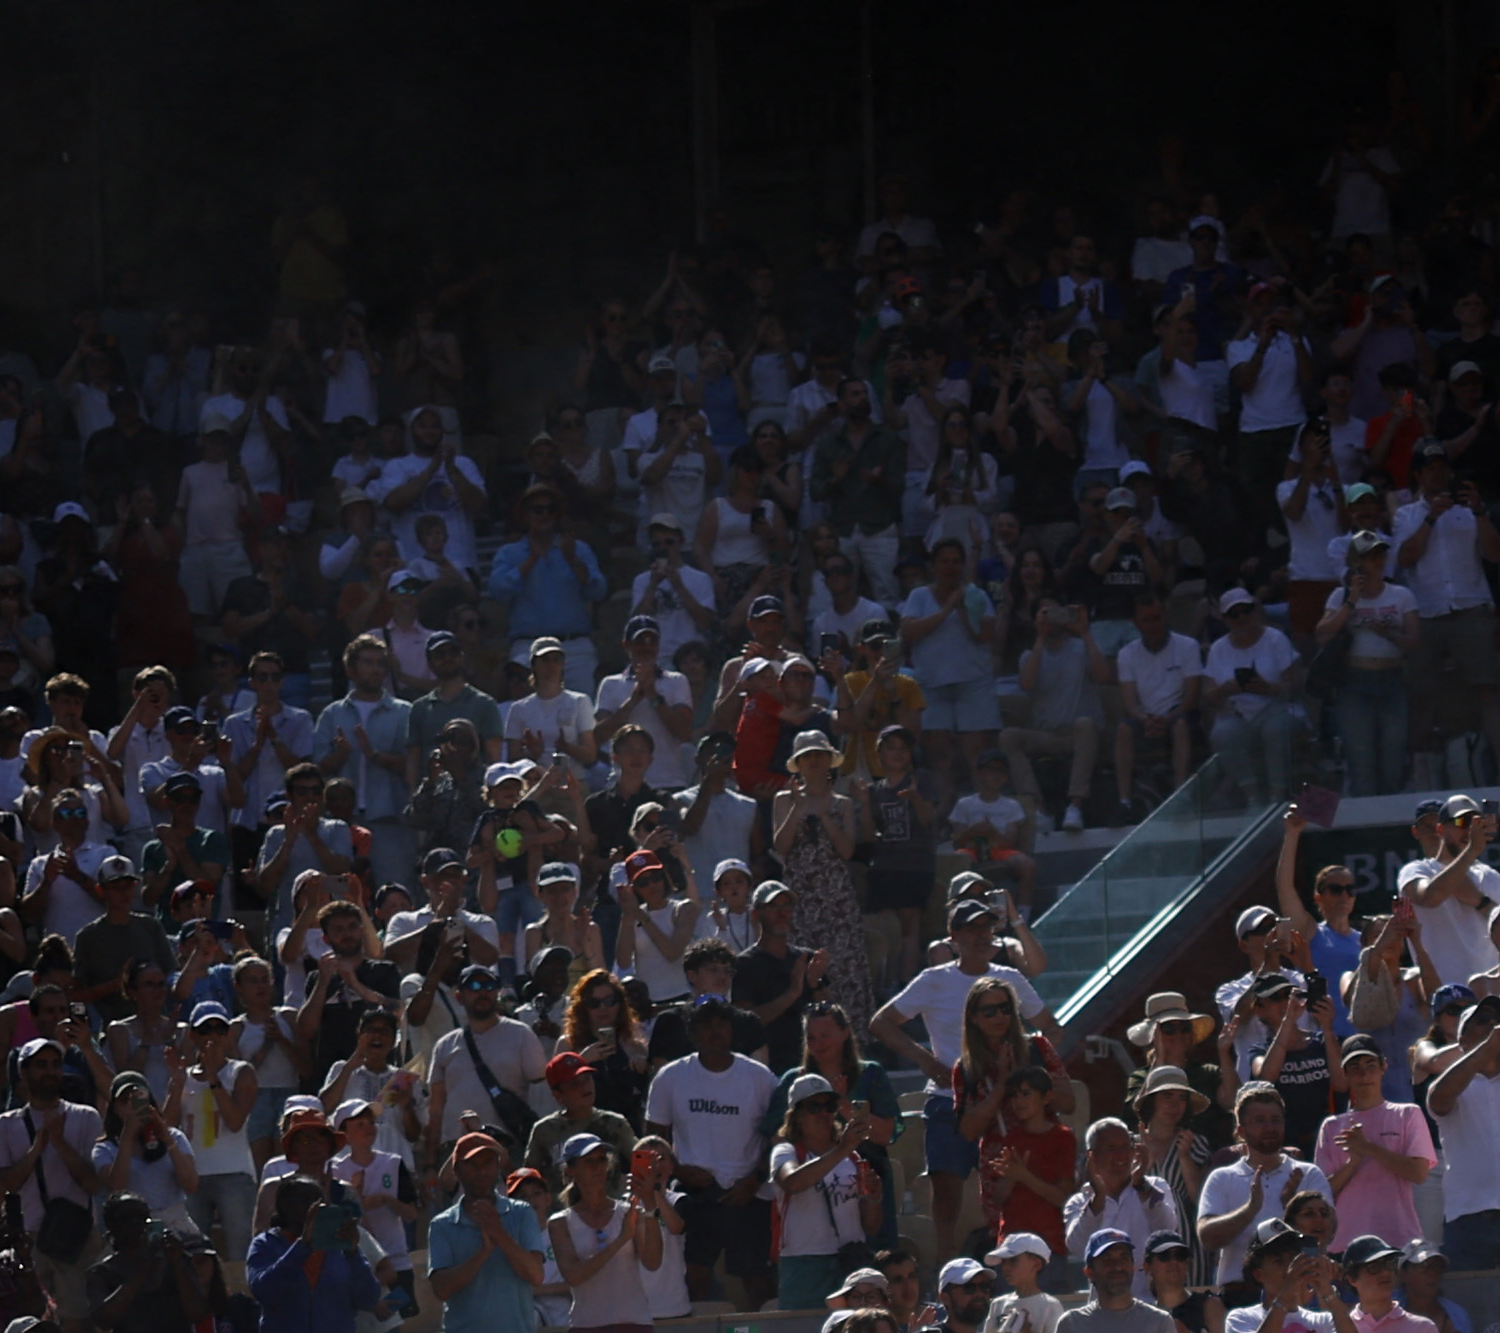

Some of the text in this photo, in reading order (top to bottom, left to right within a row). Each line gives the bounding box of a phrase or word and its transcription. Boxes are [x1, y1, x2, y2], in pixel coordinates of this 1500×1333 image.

[1346, 850, 1418, 894] BN
[1281, 1058, 1326, 1072] OLAND
[1279, 1068, 1330, 1085] GARROS
[689, 1099, 740, 1116] Wilson
